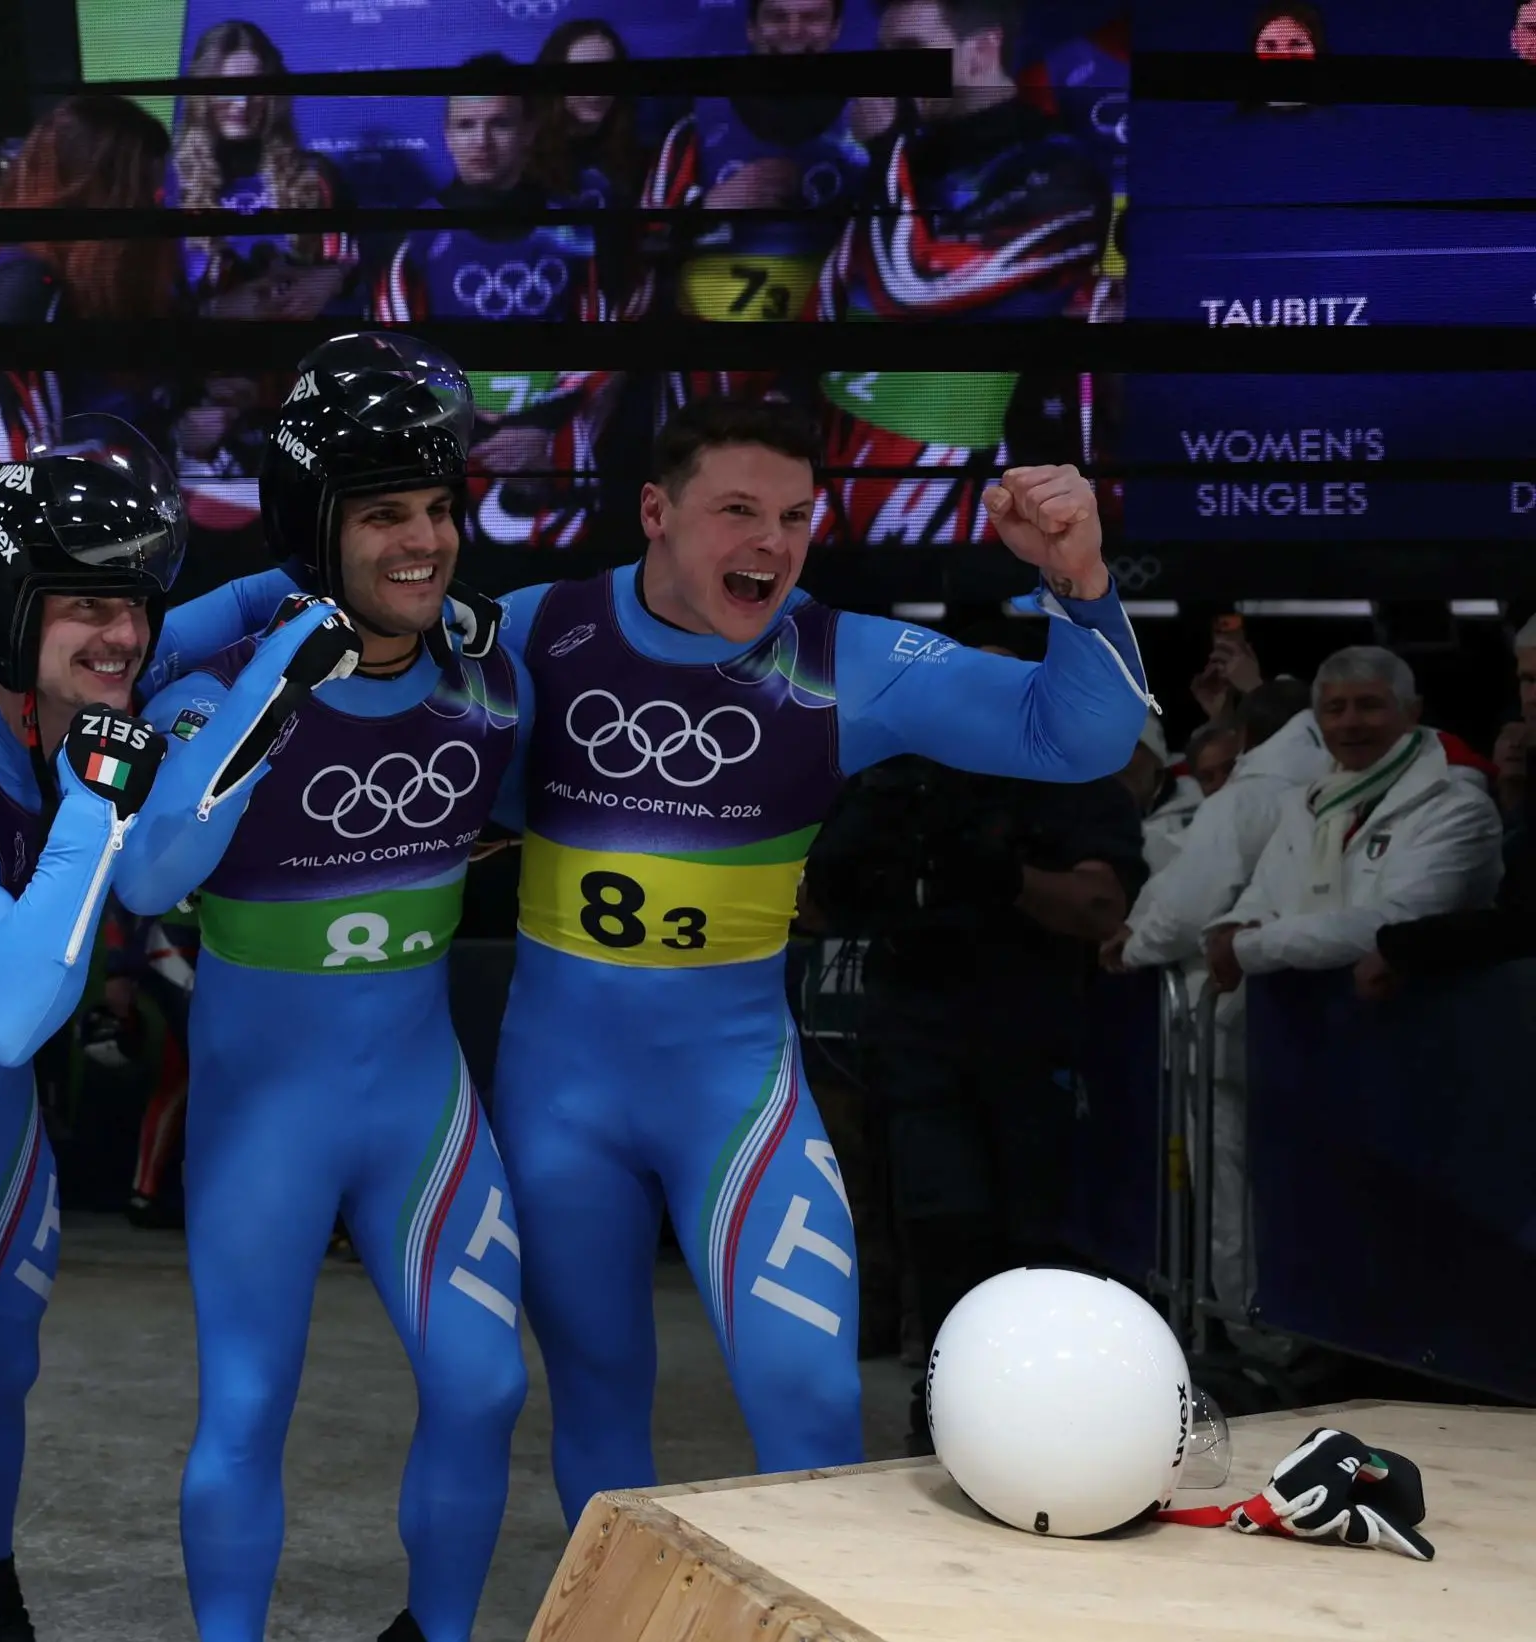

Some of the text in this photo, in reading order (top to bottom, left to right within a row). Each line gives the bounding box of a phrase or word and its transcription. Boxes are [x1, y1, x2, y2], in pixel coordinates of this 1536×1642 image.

[1199, 296, 1370, 328] TAUBITZ
[277, 426, 317, 470] uvex
[1180, 428, 1385, 463] WOMEN'S
[1196, 482, 1370, 516] SINGLES
[81, 714, 150, 750] SEIZ
[545, 781, 762, 818] MILANO CORTINA 2026
[279, 850, 367, 867] MILANO
[370, 839, 450, 862] CORTINA
[448, 1180, 521, 1328] IT
